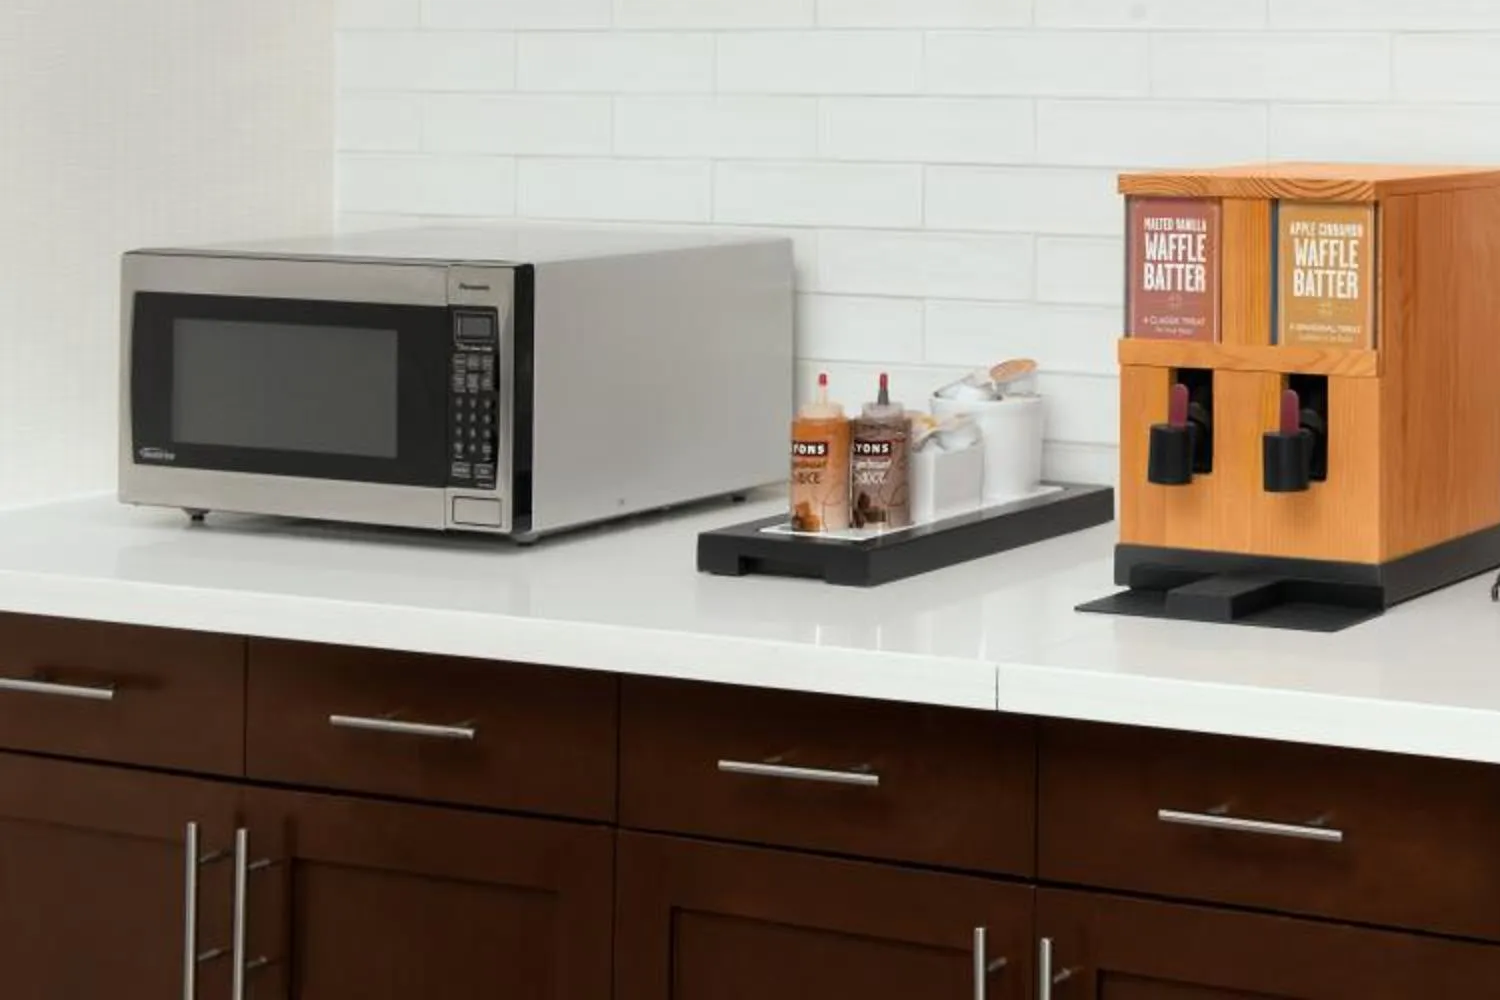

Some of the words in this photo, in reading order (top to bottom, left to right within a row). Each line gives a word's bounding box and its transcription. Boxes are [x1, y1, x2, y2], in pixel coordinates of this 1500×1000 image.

[1144, 233, 1207, 262] WAFFLE
[1294, 238, 1359, 269] WAFFLE
[1143, 262, 1206, 293] BATTER
[1293, 268, 1359, 299] BATTER
[856, 442, 889, 454] YONS
